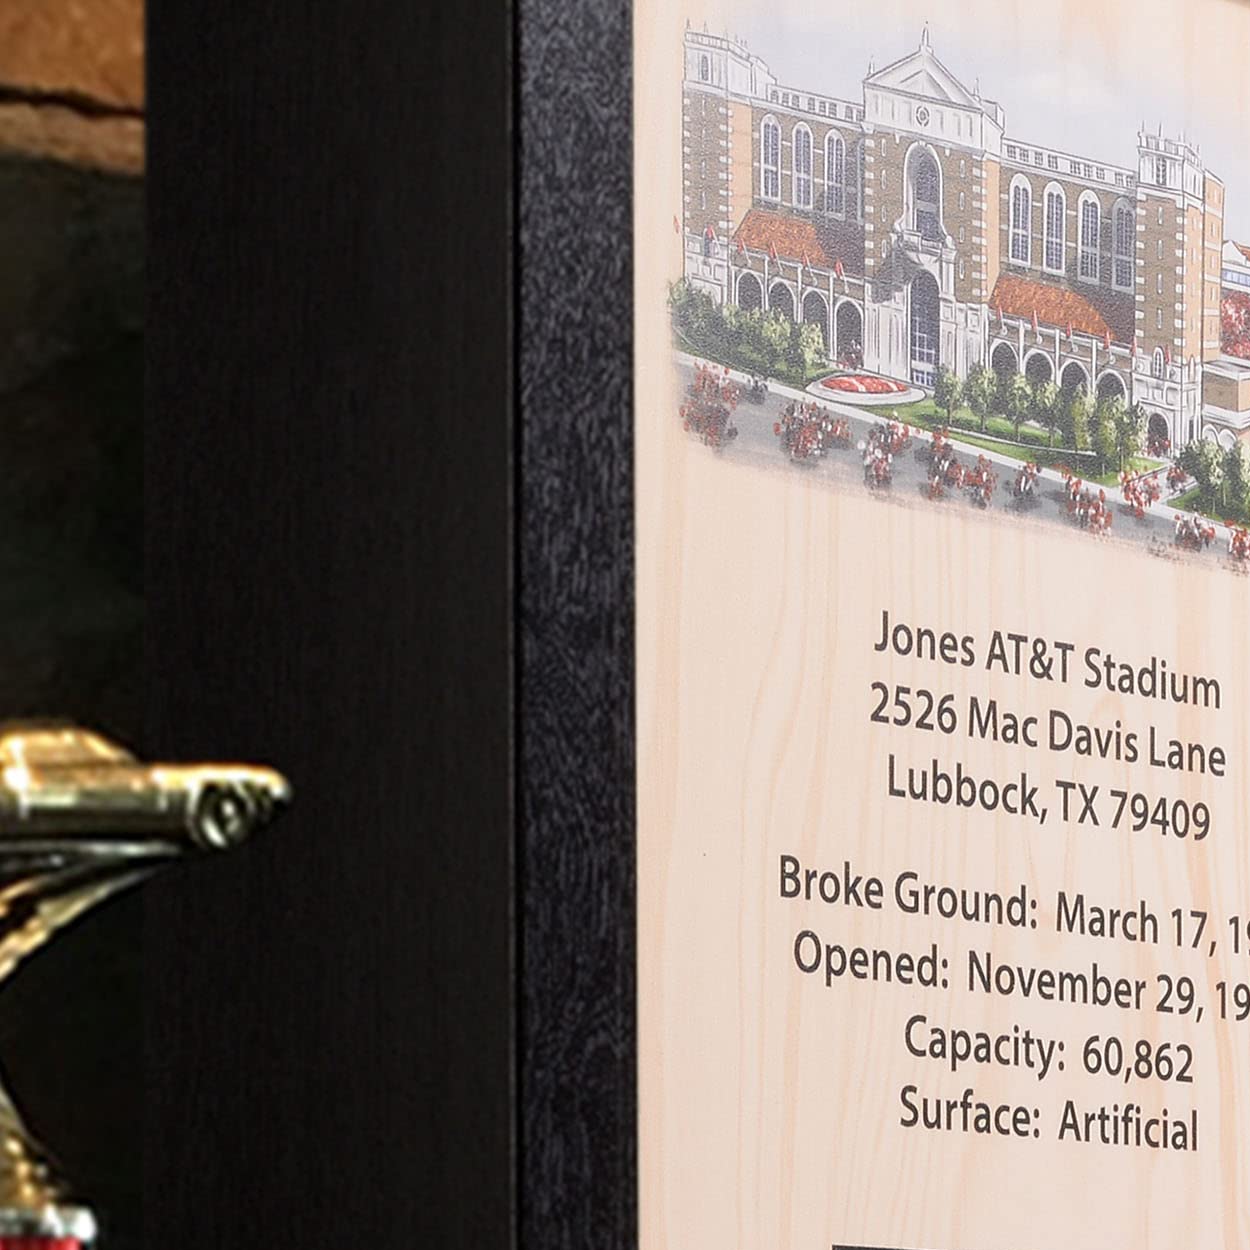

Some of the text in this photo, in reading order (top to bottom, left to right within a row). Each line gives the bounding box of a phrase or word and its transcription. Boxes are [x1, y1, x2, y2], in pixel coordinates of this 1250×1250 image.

[874, 610, 1221, 709] Jones AT&T Stadium
[870, 681, 1226, 777] 2526 Mac Davis Lane
[888, 753, 1210, 841] Lubbock, TX 79409
[780, 854, 884, 910] Broke
[894, 871, 1037, 929] Ground:
[1056, 891, 1158, 944] March
[1171, 908, 1217, 958] 17,
[793, 929, 949, 989] Opened:
[968, 950, 1147, 1010] November
[1155, 974, 1204, 1023] 29,
[904, 1014, 1194, 1084] Capacity: 60,862
[900, 1084, 1198, 1152] Surface: Artificial
